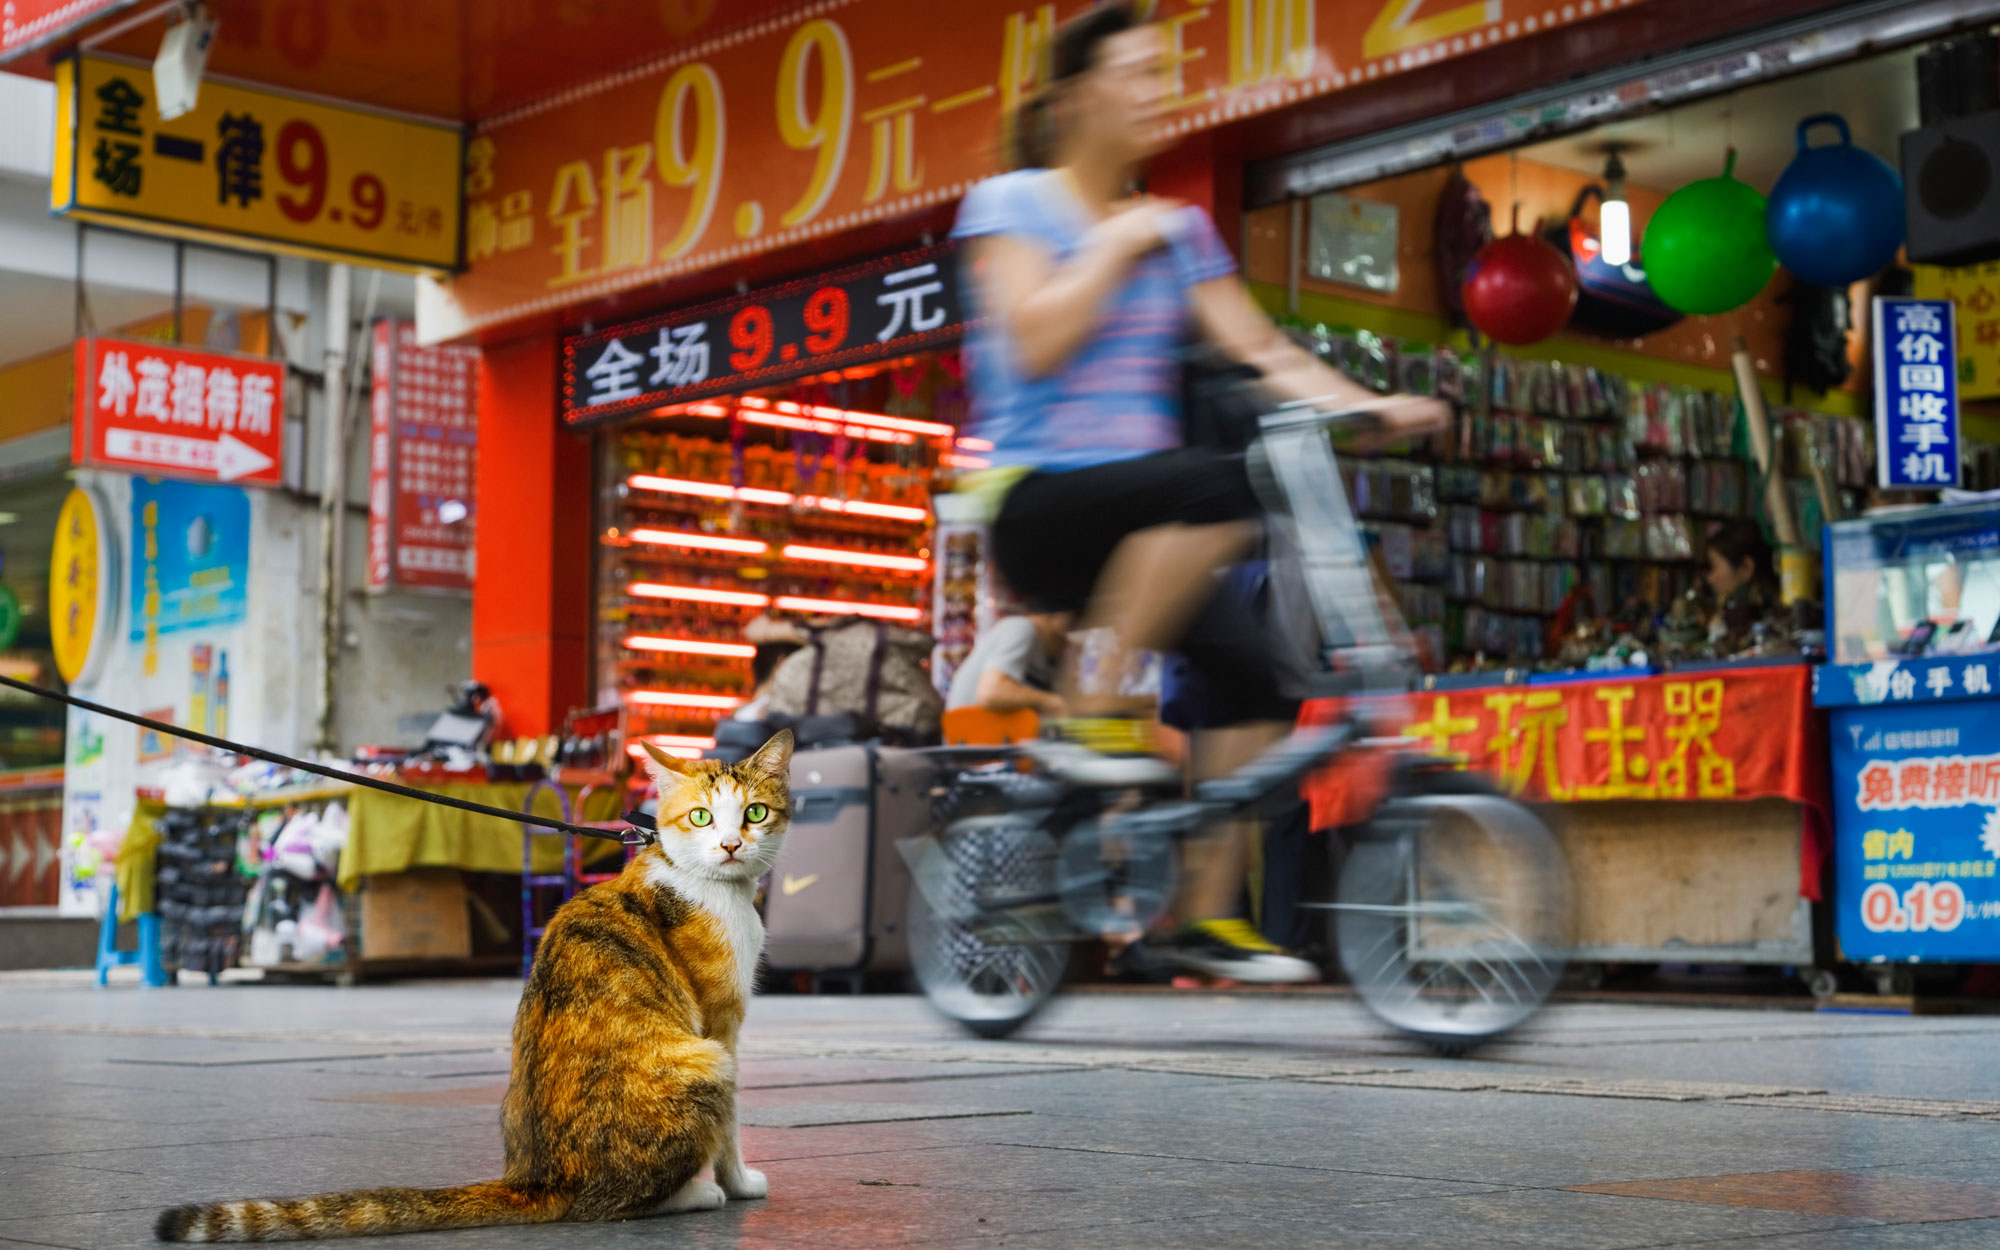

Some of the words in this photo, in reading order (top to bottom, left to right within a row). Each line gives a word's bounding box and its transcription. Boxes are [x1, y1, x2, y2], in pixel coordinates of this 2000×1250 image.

[100, 350, 275, 434] 外茂招待所
[1894, 303, 1951, 482] 高价回收手机
[1853, 661, 1992, 704] 价手机
[1866, 888, 1960, 926] 0.19
